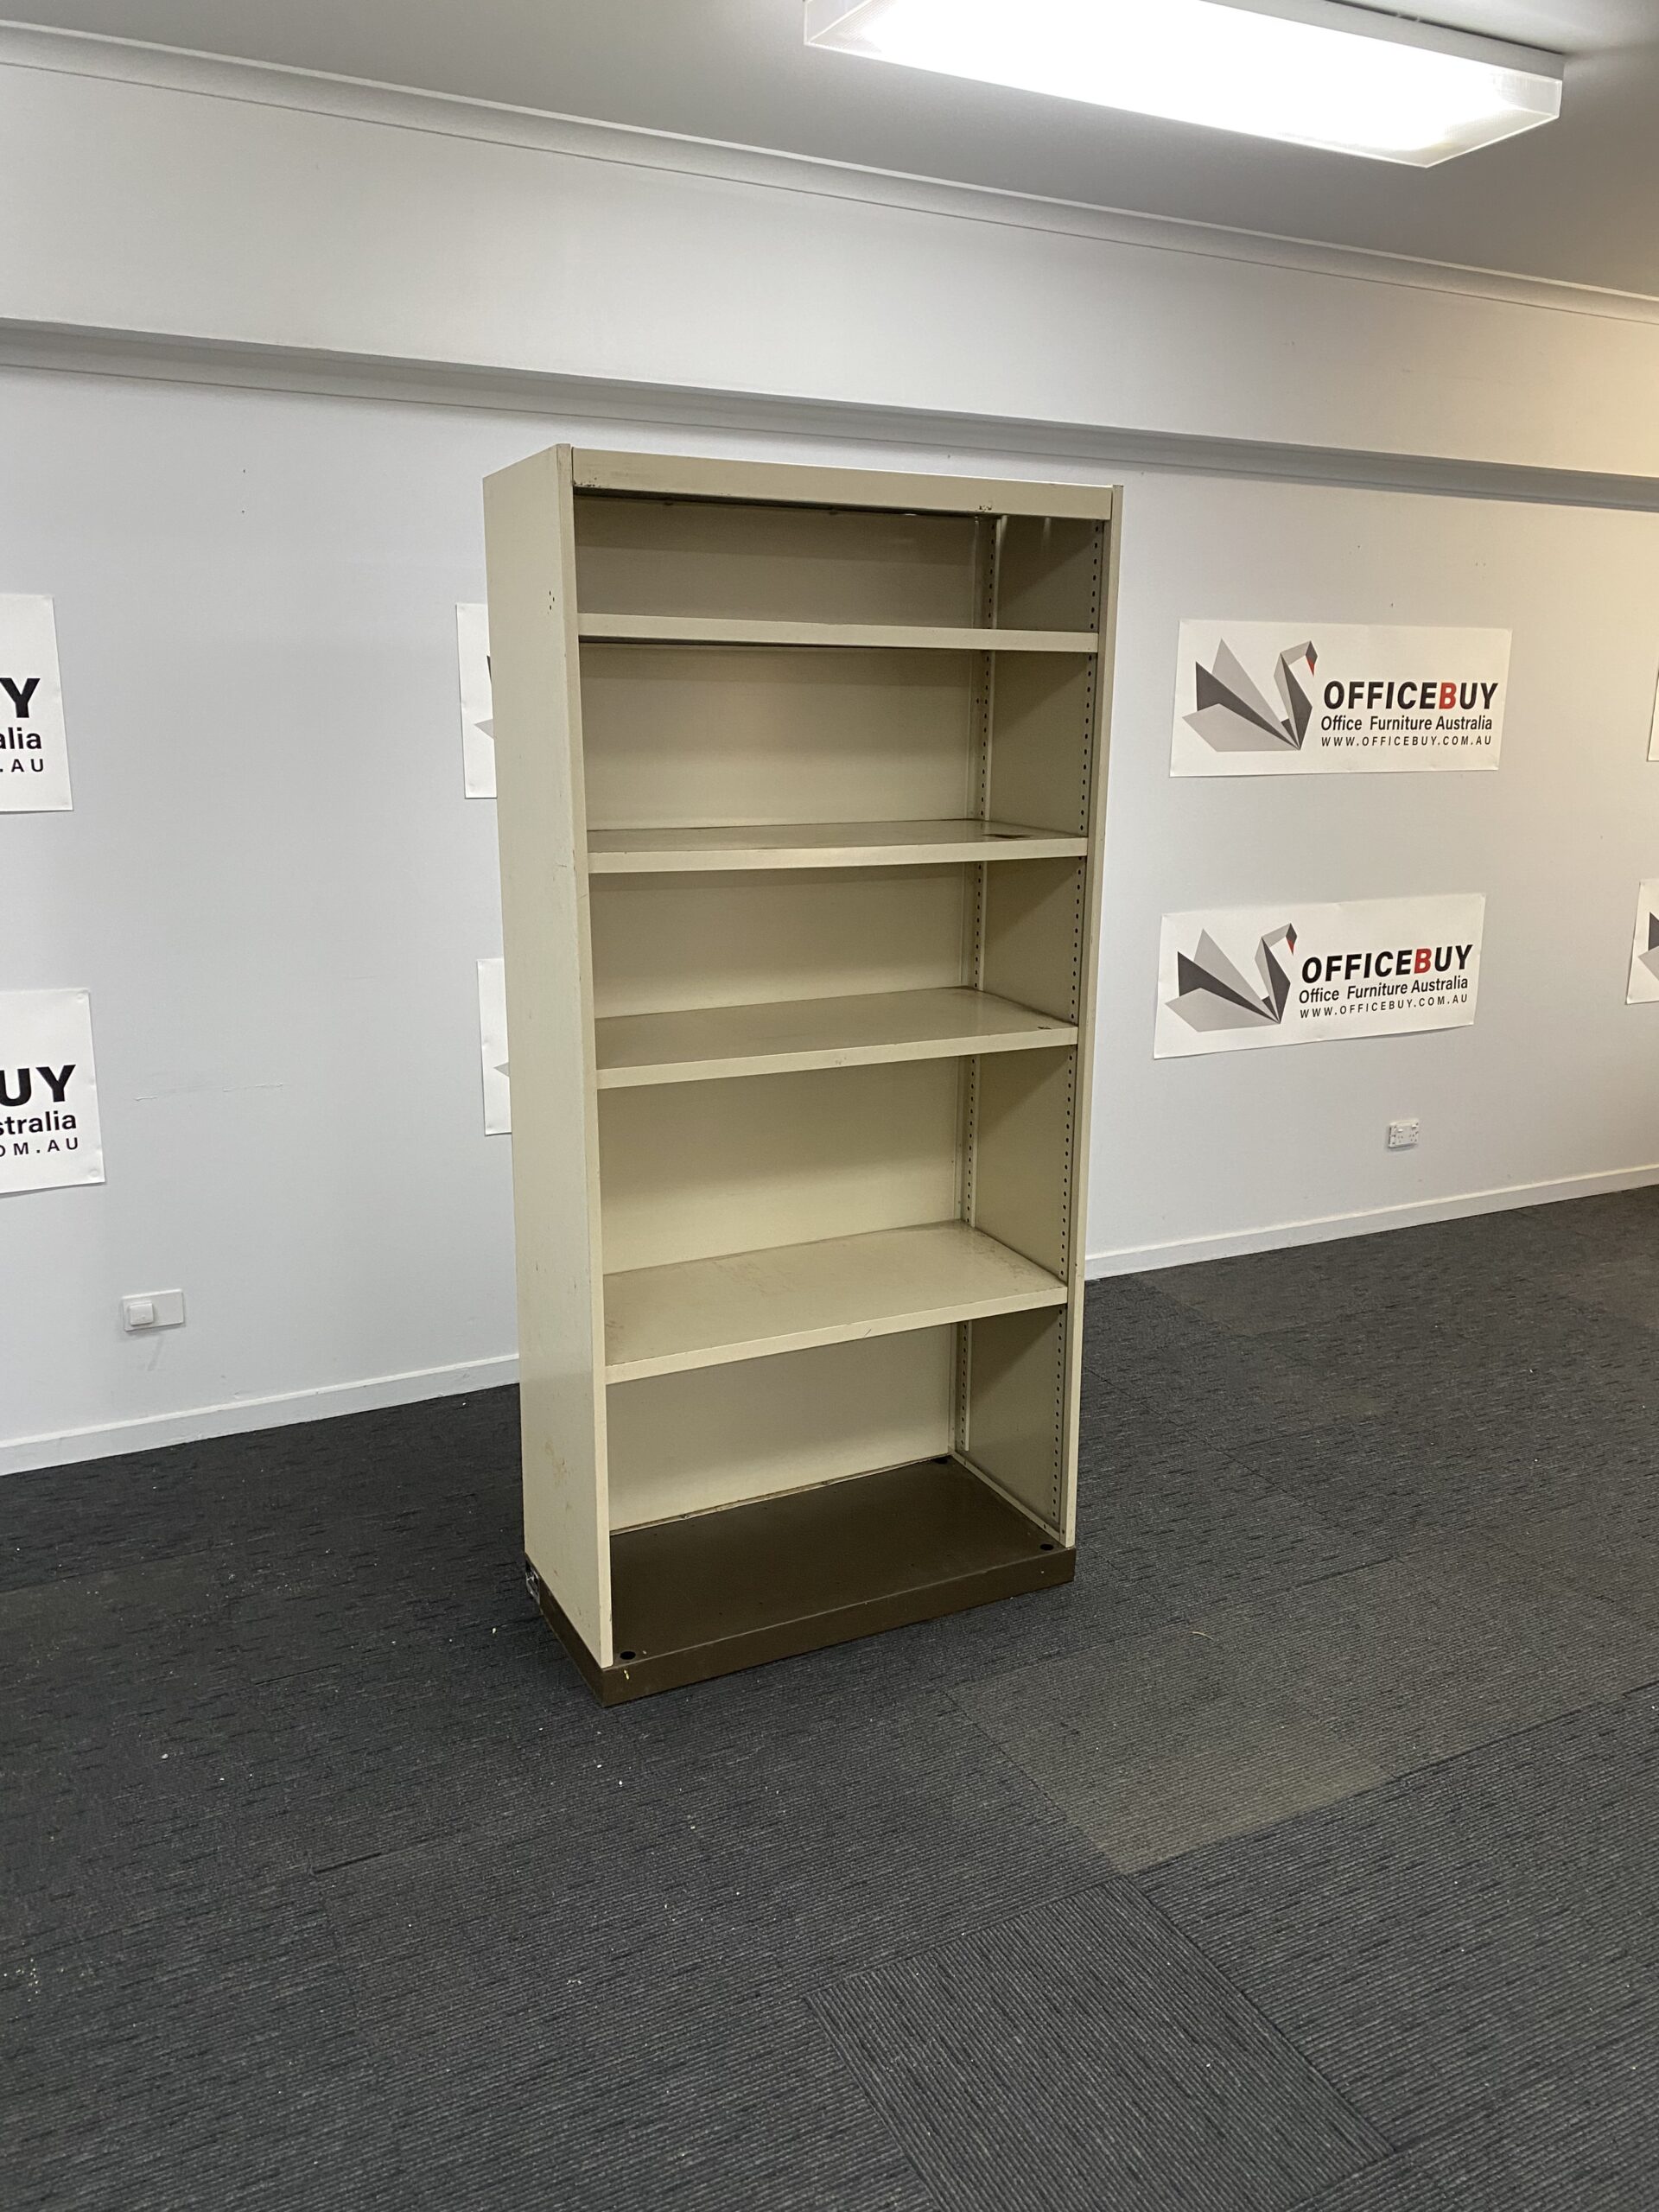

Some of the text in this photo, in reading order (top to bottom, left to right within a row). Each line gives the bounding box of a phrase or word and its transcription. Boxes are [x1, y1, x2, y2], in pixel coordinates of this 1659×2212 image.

[1324, 680, 1499, 710] OFFICEBUY
[1320, 715, 1492, 731] Office Furniture Australia
[1321, 735, 1492, 747] WWW.OFFICEBUY.COM.AU
[1301, 944, 1473, 984] OFFICEBUY
[1299, 975, 1469, 1004] Office Furniture Australia
[1300, 994, 1469, 1019] WWW.OFFICEBUY.COM.AU
